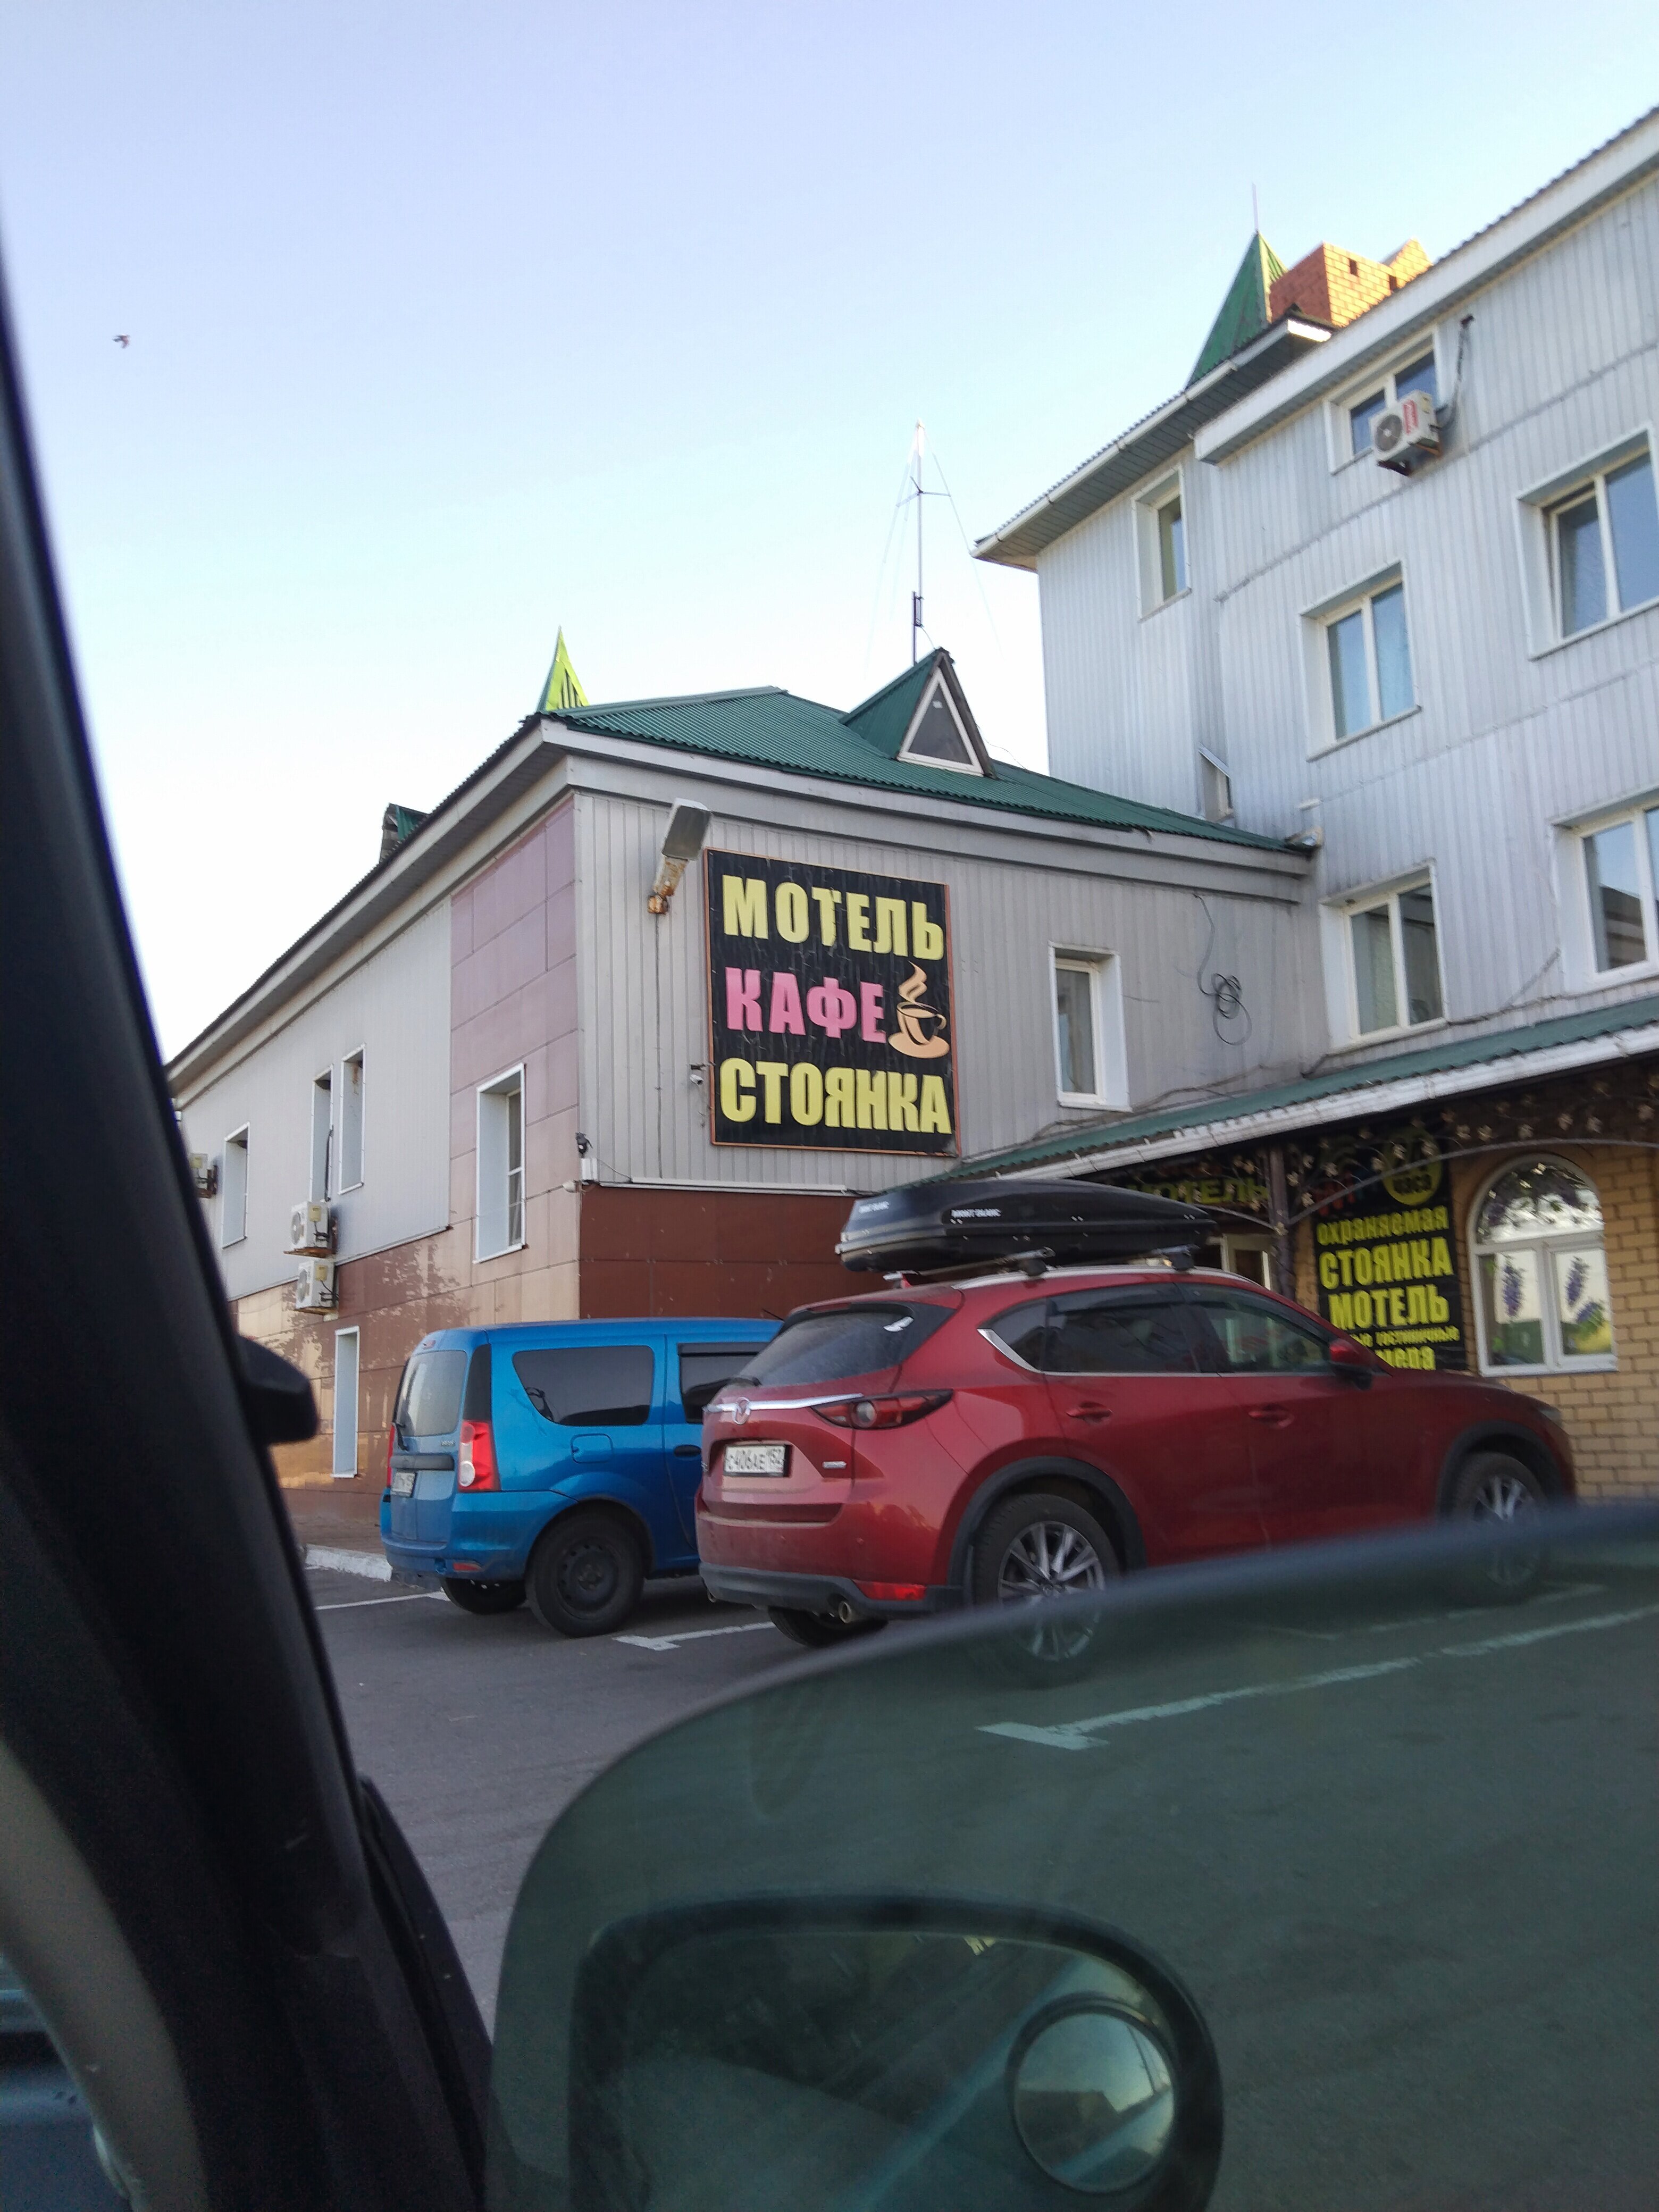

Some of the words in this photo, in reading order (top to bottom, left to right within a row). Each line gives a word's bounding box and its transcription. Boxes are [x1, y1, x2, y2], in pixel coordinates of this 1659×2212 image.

[722, 874, 944, 960] МОТЕЛЬ
[725, 967, 886, 1043] КАФЕ
[719, 1058, 952, 1134] СТОЯНКА
[1319, 1237, 1454, 1289] СТОЯНКА
[1328, 1284, 1450, 1330] МОТЕЛЬ
